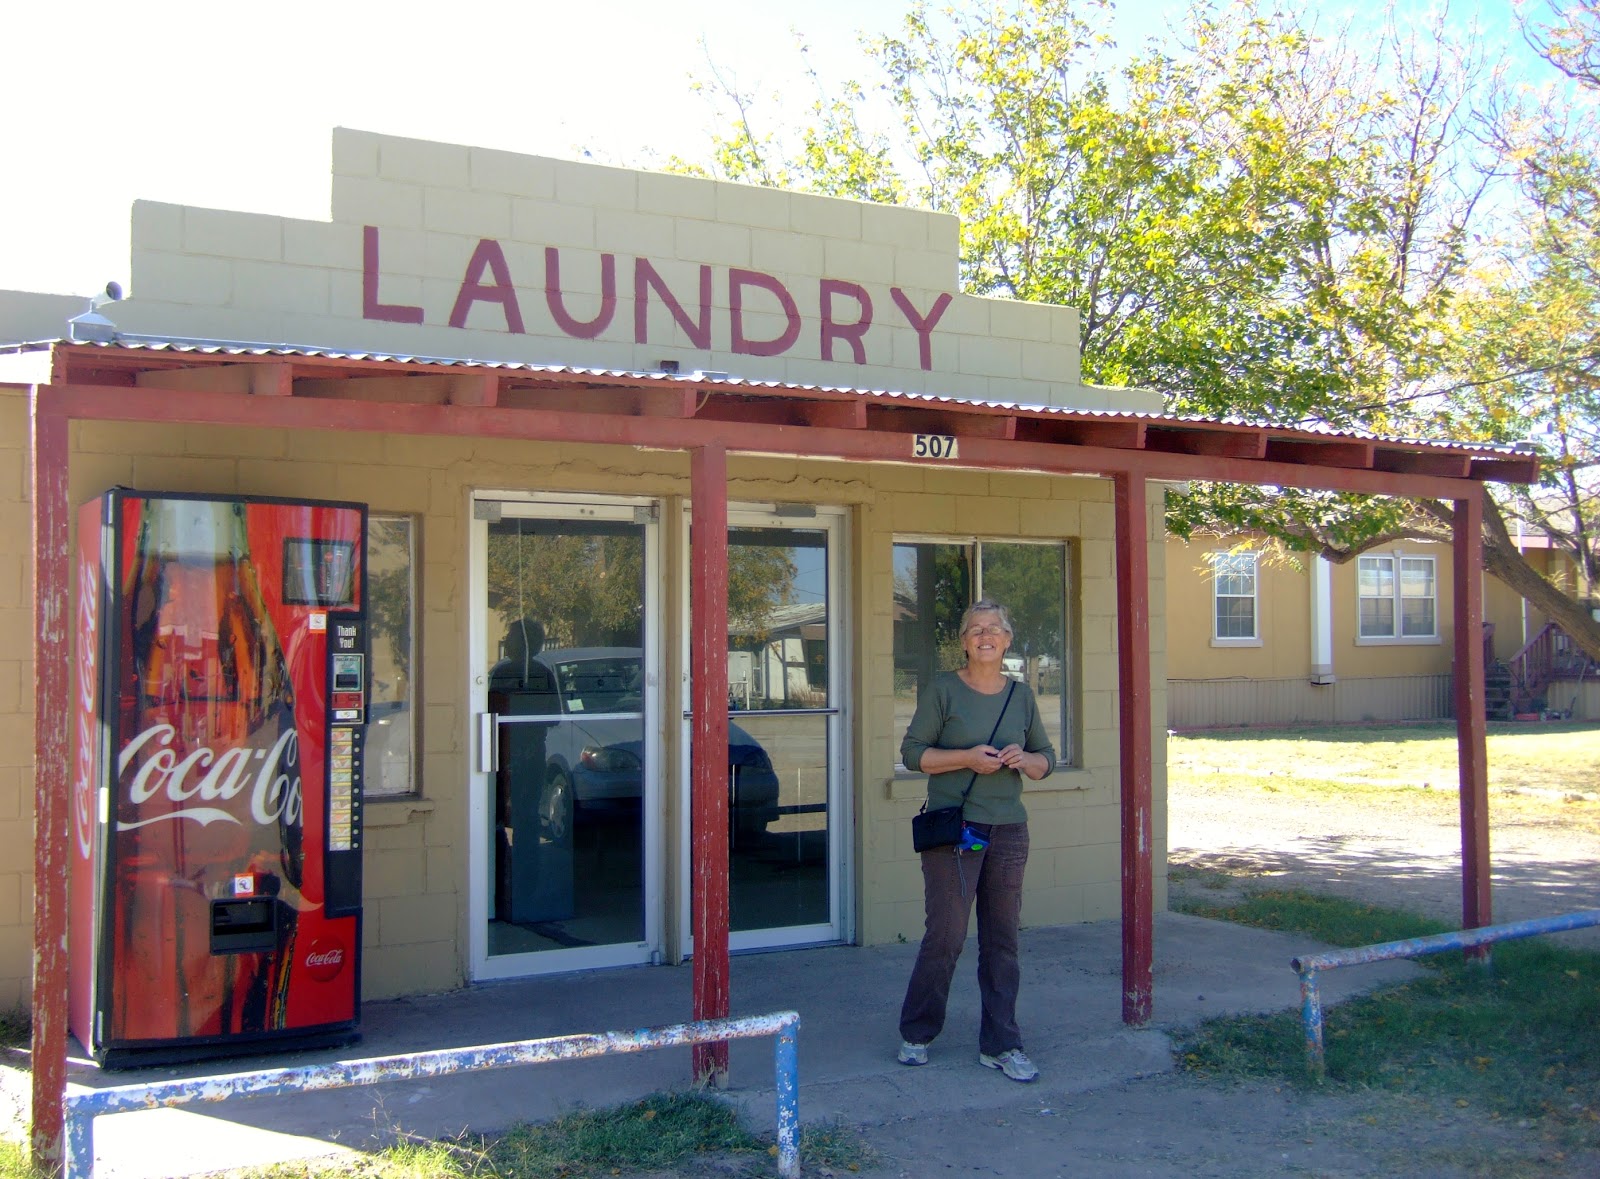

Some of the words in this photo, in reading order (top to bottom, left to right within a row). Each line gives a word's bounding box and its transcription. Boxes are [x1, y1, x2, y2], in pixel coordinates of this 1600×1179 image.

[362, 225, 953, 371] LAUNDRY
[915, 434, 955, 458] 507
[337, 625, 357, 637] Thank
[339, 637, 355, 649] You!
[118, 724, 304, 830] Coca-Co
